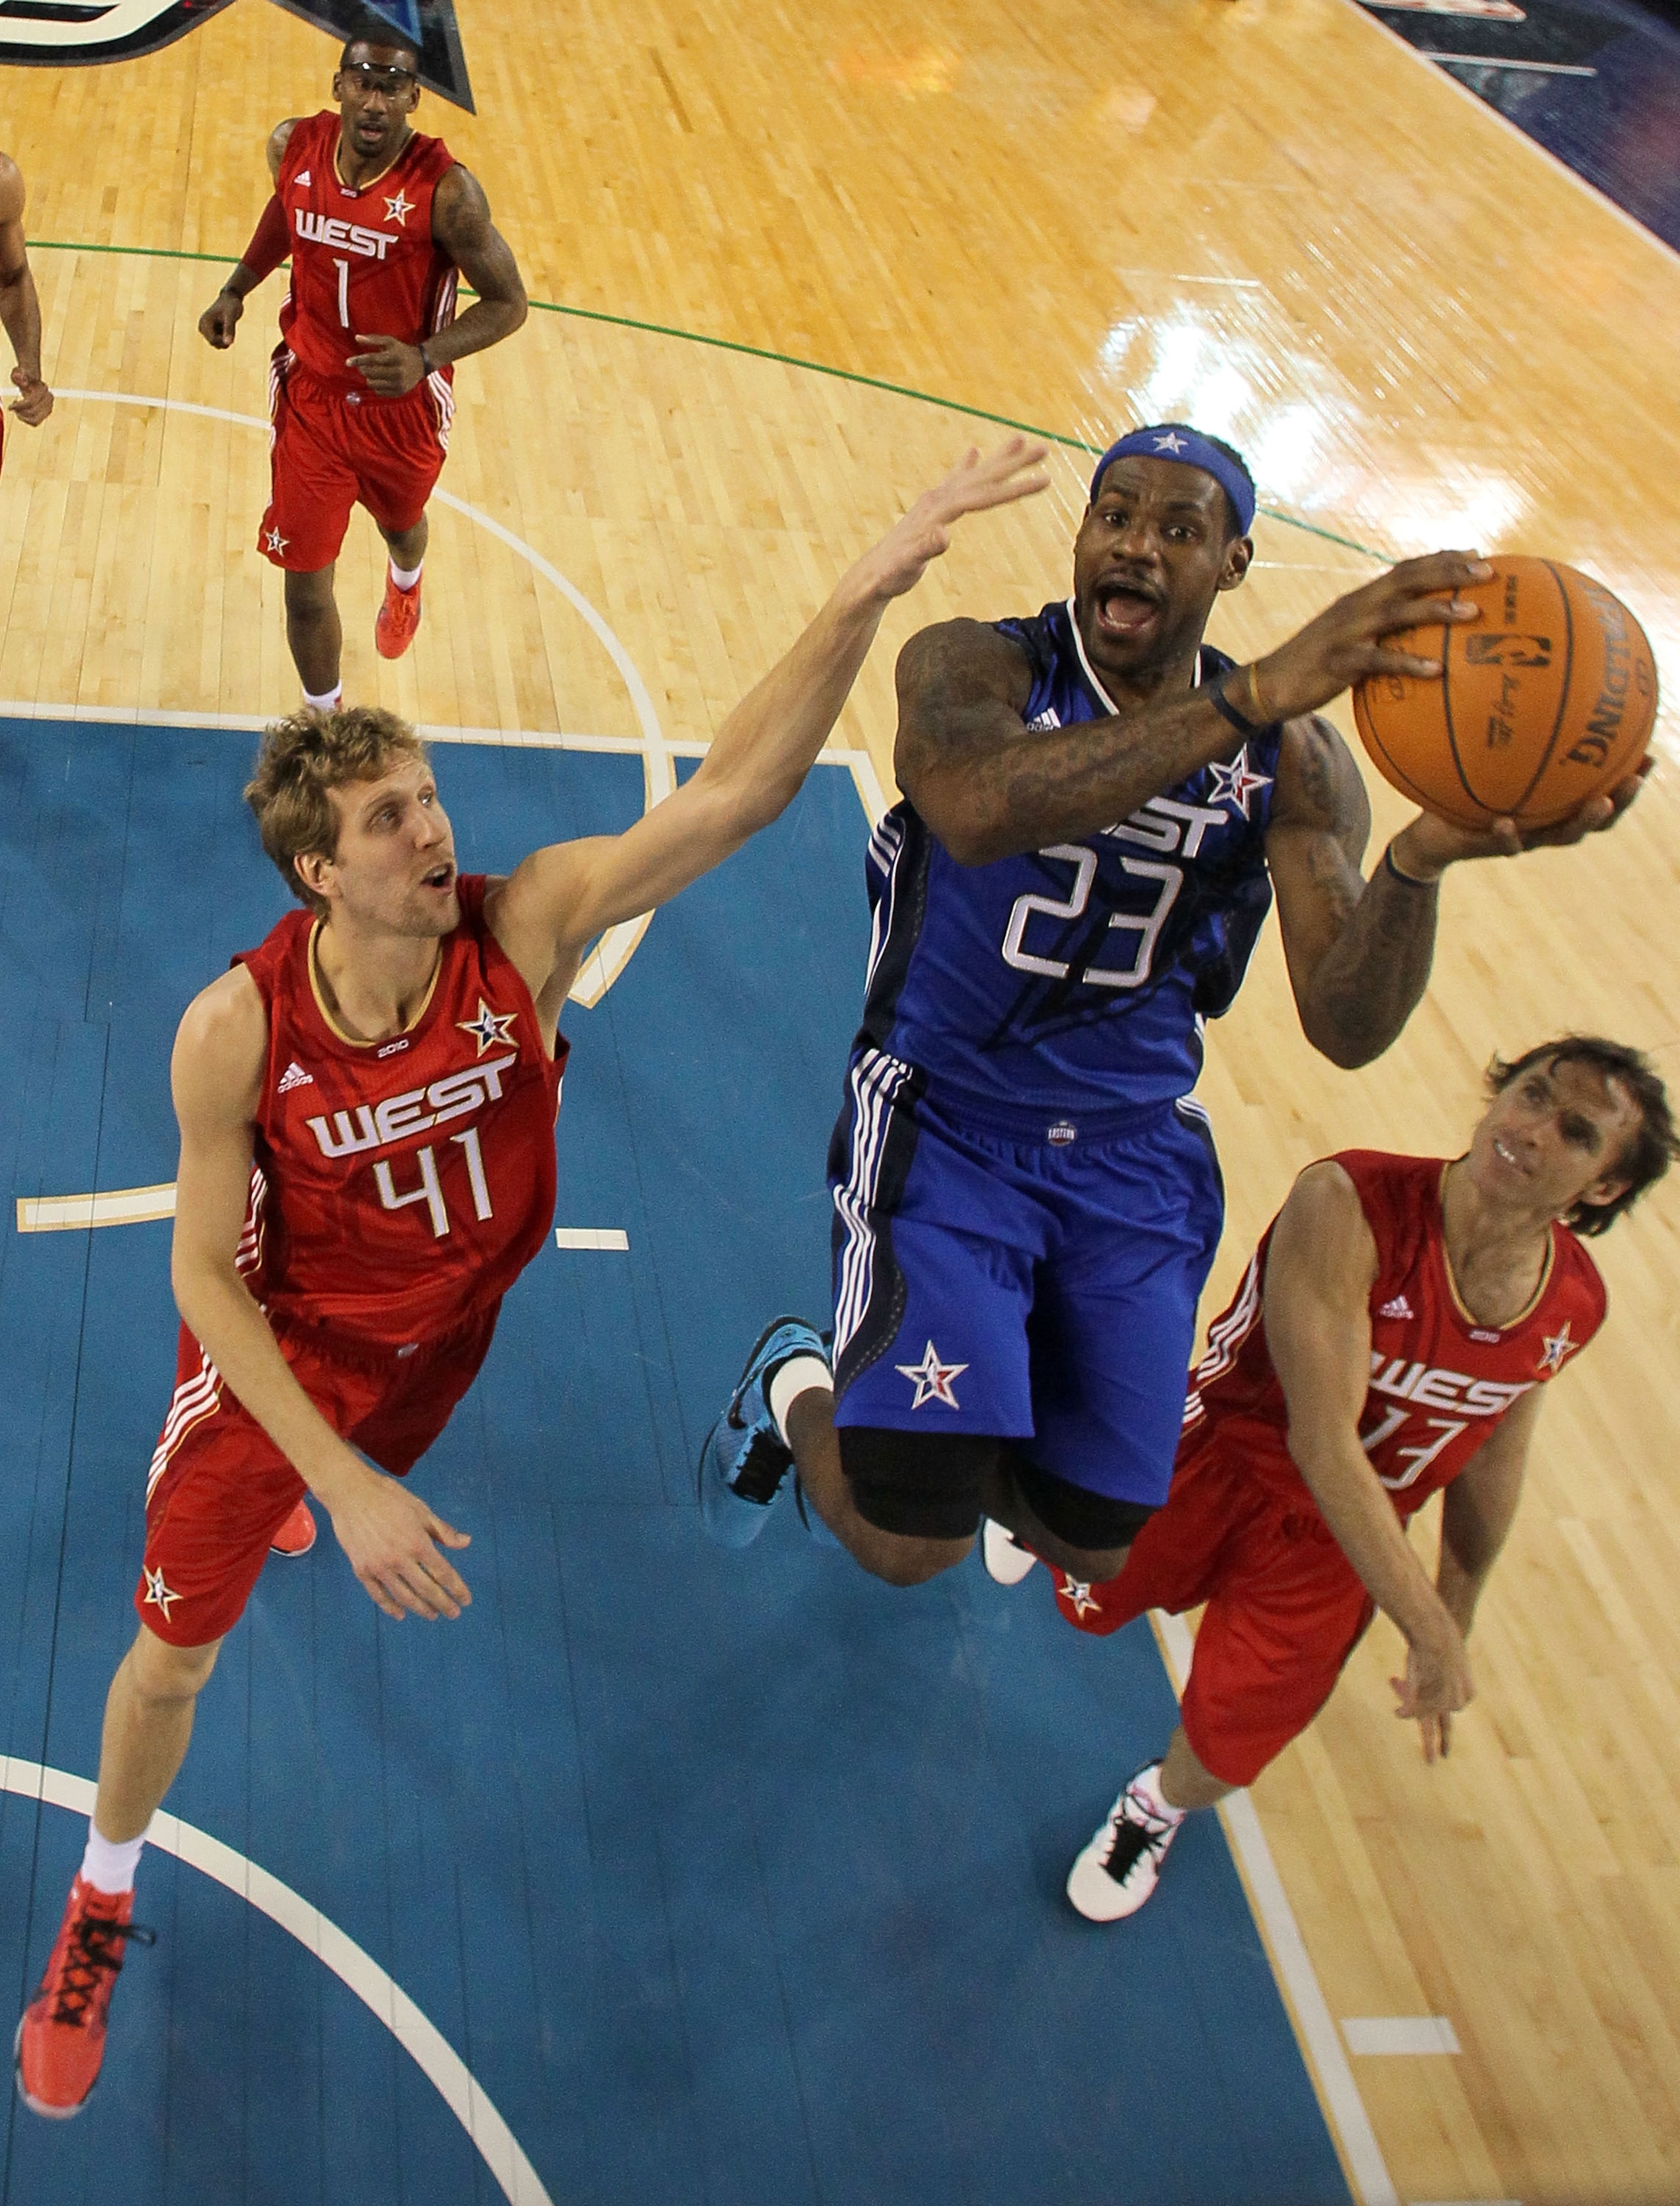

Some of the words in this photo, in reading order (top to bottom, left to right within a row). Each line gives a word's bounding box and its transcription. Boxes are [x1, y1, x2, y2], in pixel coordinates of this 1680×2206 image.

[295, 207, 399, 260] WEST
[332, 257, 349, 328] 1
[1001, 843, 1184, 988] 23
[277, 1074, 314, 1093] adidas
[377, 1039, 410, 1058] 2010
[304, 1052, 518, 1159] WEST
[372, 1127, 494, 1239] 41
[1362, 1404, 1471, 1491] 13
